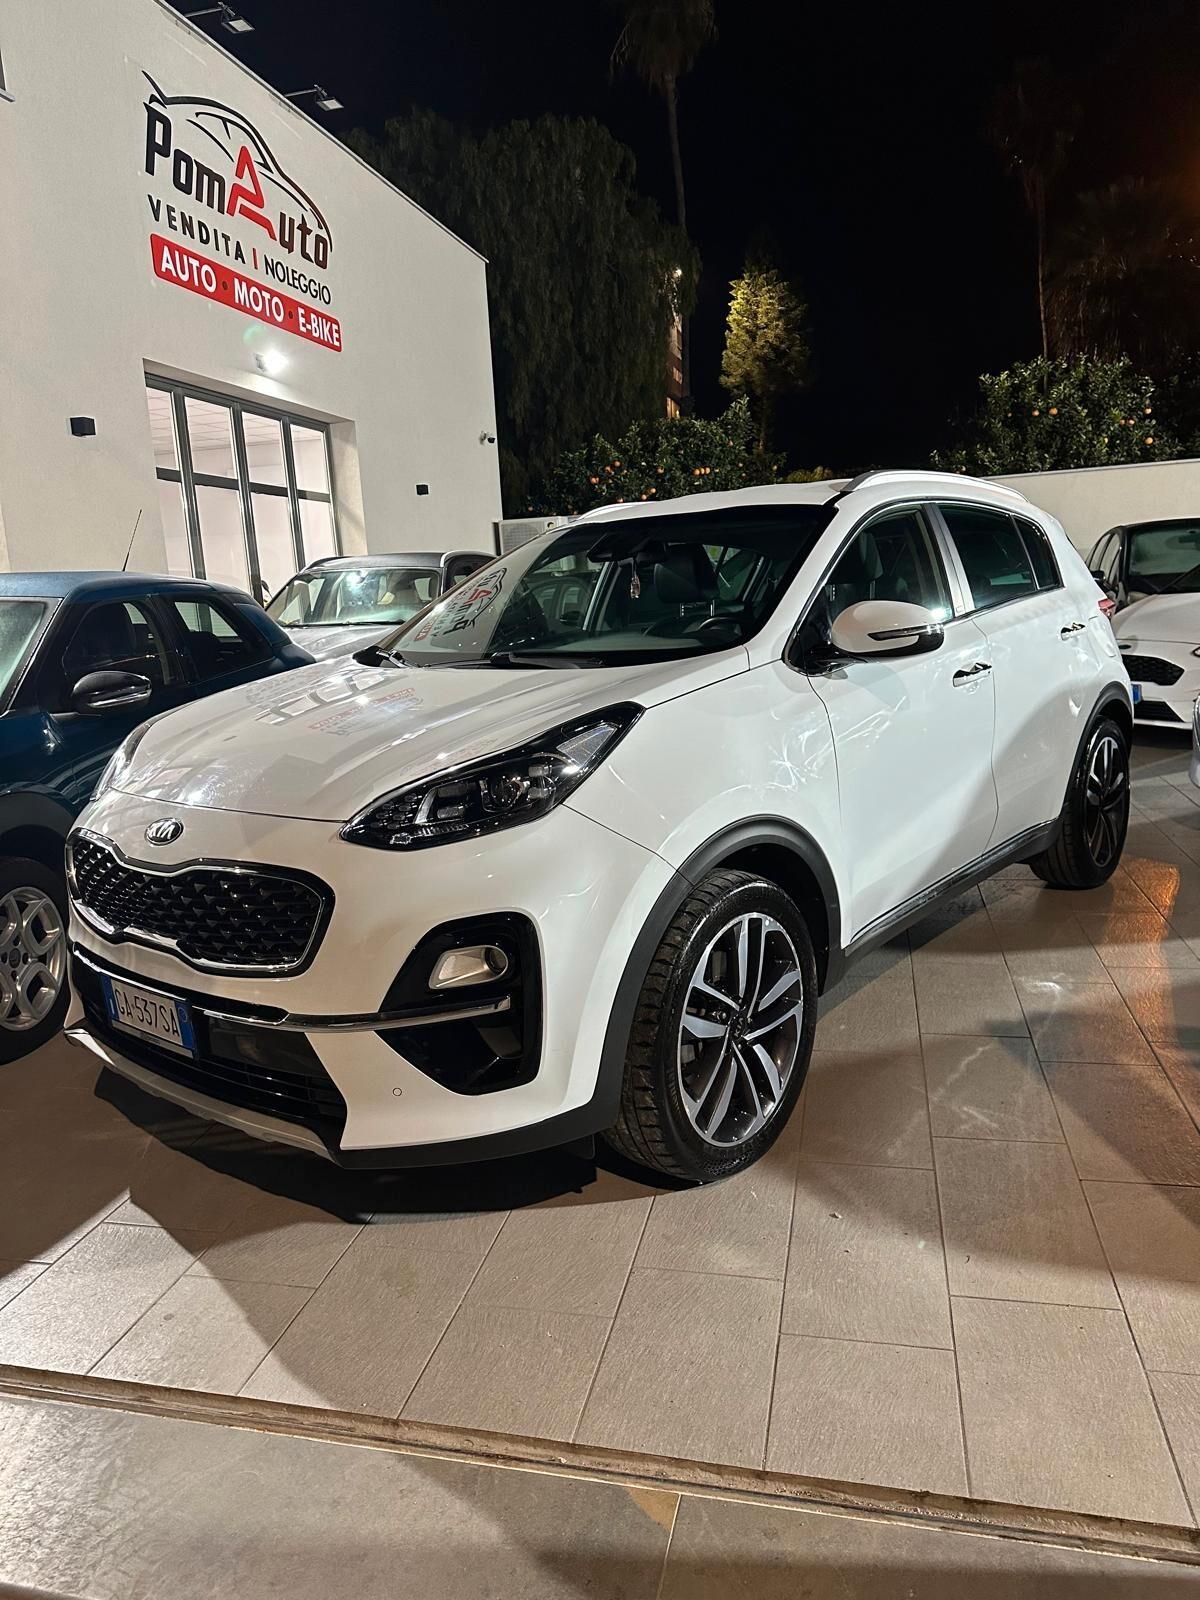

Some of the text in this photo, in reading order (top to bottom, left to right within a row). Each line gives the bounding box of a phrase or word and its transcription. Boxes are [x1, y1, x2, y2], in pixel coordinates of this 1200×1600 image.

[147, 194, 331, 305] VENDITA NOLEGGIO
[161, 245, 341, 347] AUTO MOTO E-BIKE
[147, 819, 176, 840] KIA
